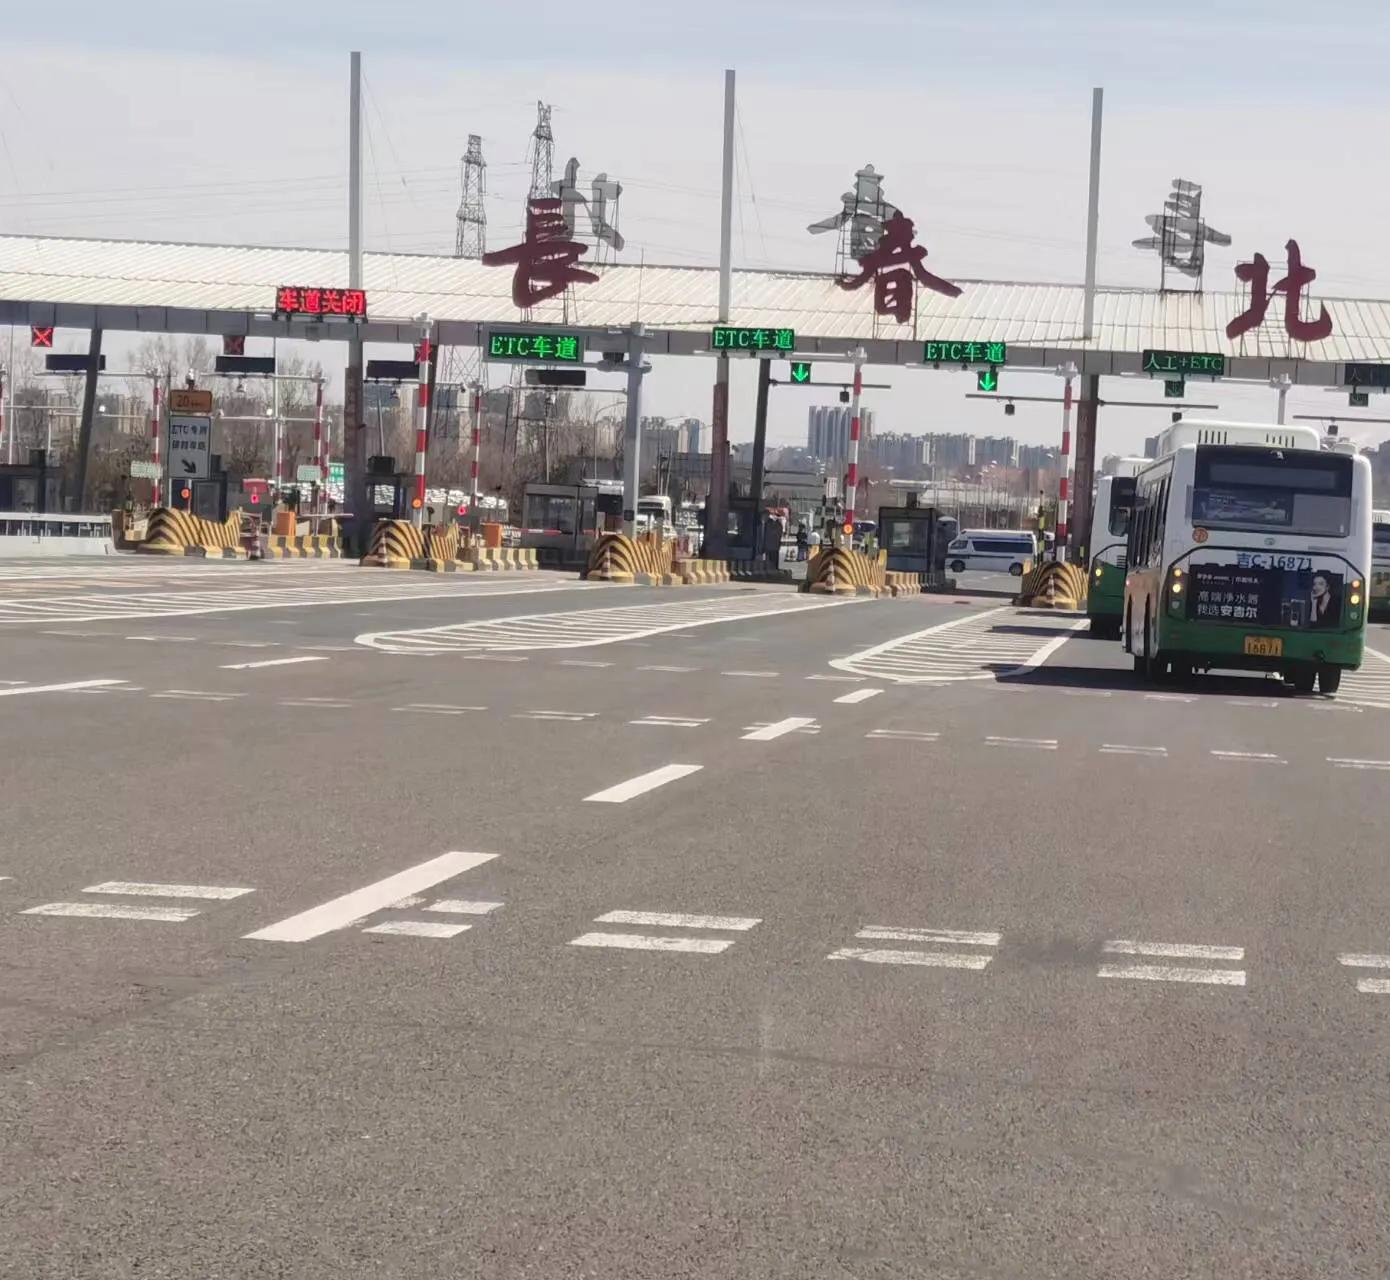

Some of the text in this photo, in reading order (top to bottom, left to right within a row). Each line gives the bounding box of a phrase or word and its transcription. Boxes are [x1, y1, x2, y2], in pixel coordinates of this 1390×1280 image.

[279, 288, 364, 314] 车道关闭
[491, 335, 577, 359] ETC车道
[714, 329, 793, 349] ETC车道
[927, 342, 1005, 362] ETC车道
[1143, 352, 1222, 370] 人工+ETC
[1237, 553, 1313, 571] 吉C-16871
